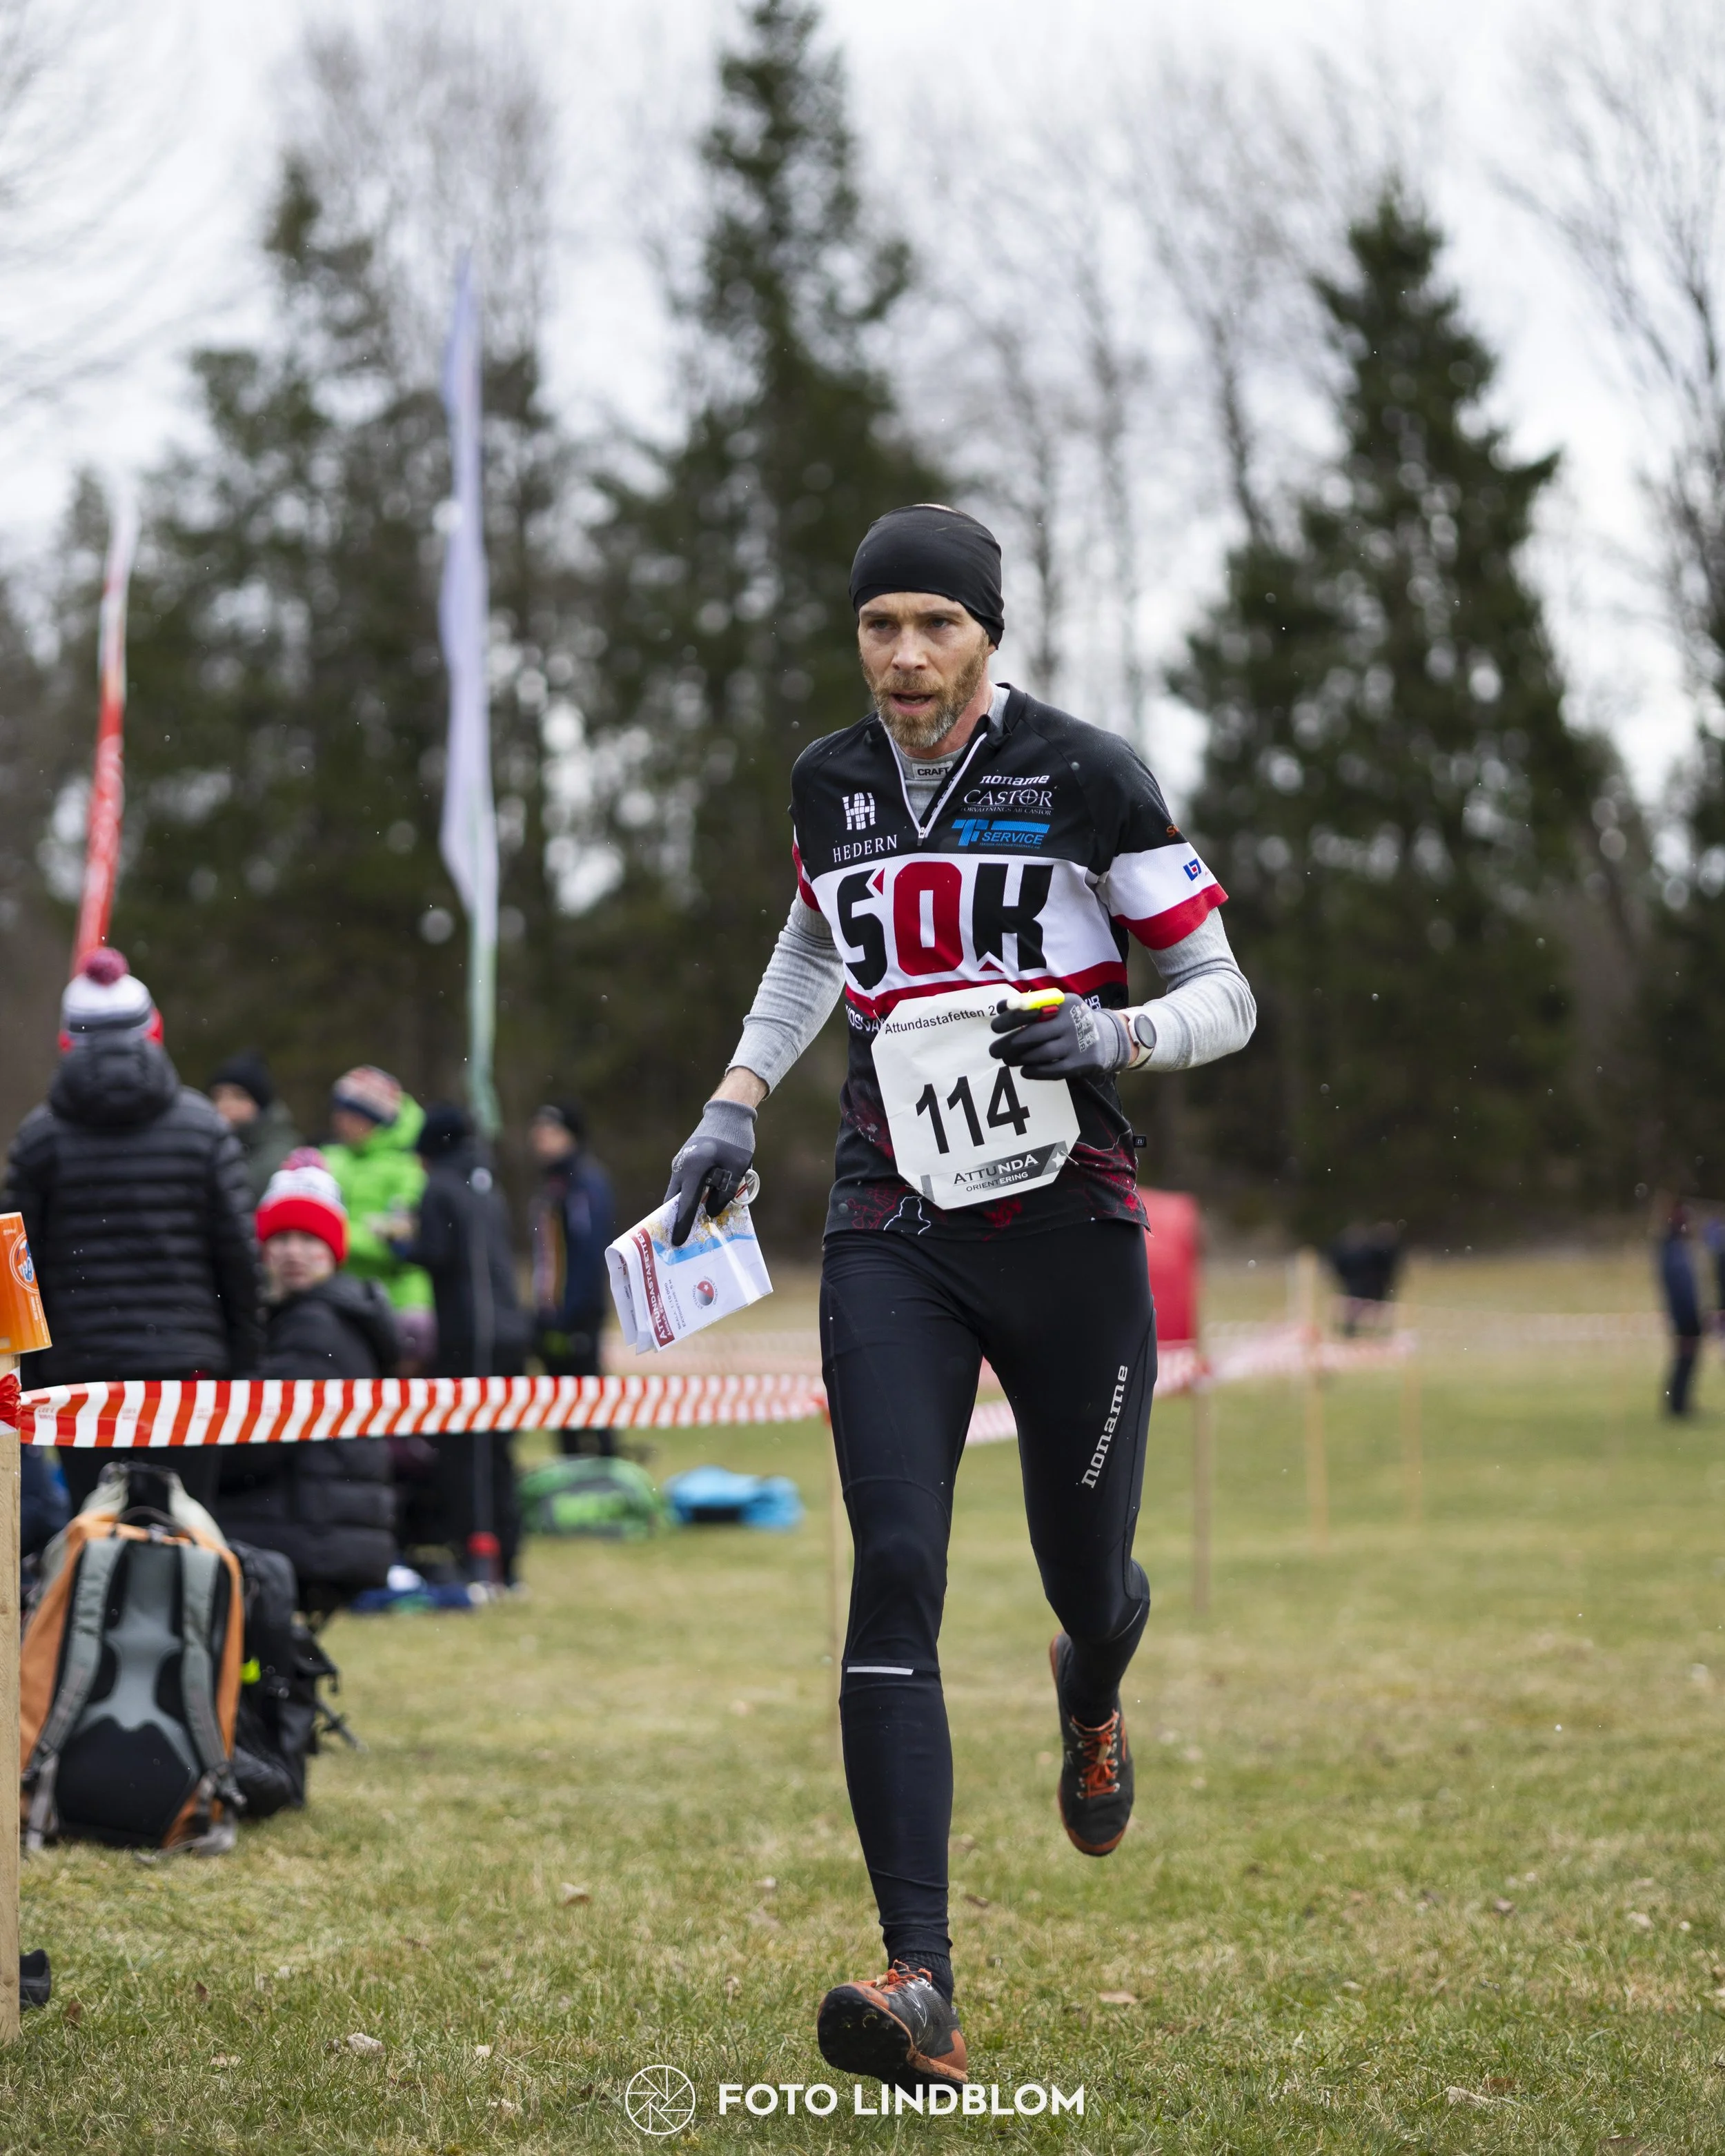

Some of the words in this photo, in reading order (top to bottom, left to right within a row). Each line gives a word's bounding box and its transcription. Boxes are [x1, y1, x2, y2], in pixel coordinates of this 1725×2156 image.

[917, 767, 949, 776] CRAFT
[980, 775, 1050, 786] noname
[963, 788, 1053, 807] CASTOR
[833, 834, 898, 863] HEDERN
[981, 831, 1044, 845] SERVICE
[836, 861, 1055, 991] SOK
[885, 1008, 985, 1035] Attundastafetten
[916, 1066, 1030, 1154] 114
[953, 1154, 1039, 1184] ATTUNDA
[966, 1171, 1028, 1192] ORIENTERING
[1081, 1365, 1128, 1489] noname
